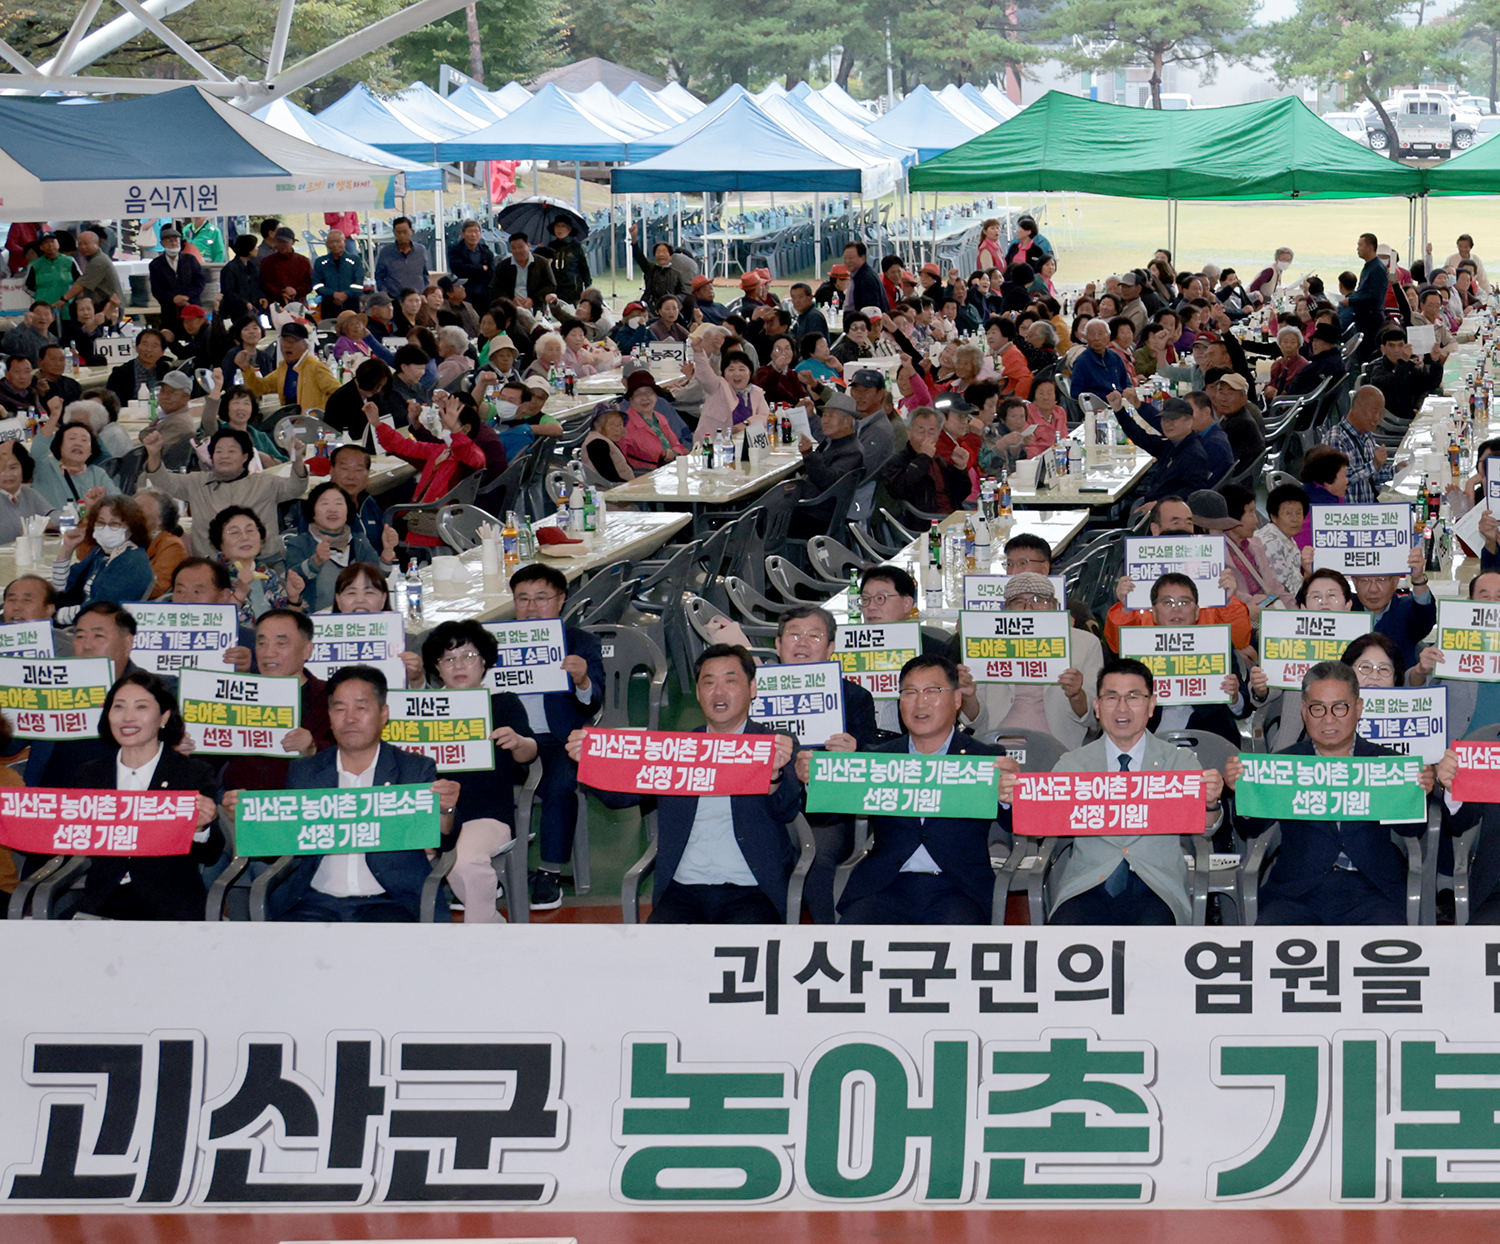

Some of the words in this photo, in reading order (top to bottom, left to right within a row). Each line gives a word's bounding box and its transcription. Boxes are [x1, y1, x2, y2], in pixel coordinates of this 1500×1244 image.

[124, 184, 218, 213] 음식지원
[1315, 530, 1347, 548] 농어촌
[1349, 530, 1372, 547] 기본
[1374, 528, 1407, 546] 소득이
[1344, 551, 1380, 567] 만든다!
[1130, 564, 1162, 581] 농어촌
[136, 612, 178, 627] 인구소멸
[180, 612, 201, 627] 없는
[203, 612, 222, 627] 괴산
[994, 616, 1034, 635] 괴산군
[1295, 616, 1336, 637] 괴산군
[166, 632, 191, 650] 기본
[193, 631, 233, 649] 소득이
[844, 629, 885, 648] 괴산군
[967, 637, 1007, 658] 농어촌
[1011, 637, 1065, 657] 기본소득
[1154, 633, 1195, 651] 괴산군
[1266, 638, 1306, 660] 농어촌
[1442, 629, 1482, 650] 농어촌
[333, 642, 359, 660] 기본
[525, 645, 562, 665] 소득이
[986, 660, 1012, 678] 선정
[1020, 660, 1047, 678] 기원!
[1170, 654, 1225, 674] 기본소득
[1458, 654, 1485, 674] 선정
[23, 665, 68, 685] 괴산군
[494, 670, 534, 688] 만든다!
[779, 672, 802, 690] 없는
[804, 672, 825, 688] 괴산
[41, 687, 105, 709] 기본소득
[215, 679, 259, 701] 괴산군
[1176, 678, 1207, 697] 기원!
[183, 701, 228, 724] 농어촌
[232, 704, 293, 727] 기본소득
[405, 697, 450, 717] 괴산군
[767, 696, 796, 716] 기본
[797, 693, 838, 714] 소득이
[1388, 698, 1408, 713] 없는
[1412, 697, 1432, 712] 괴산
[17, 712, 45, 732] 선정
[50, 712, 87, 732] 기원!
[423, 719, 485, 741] 기본소득
[1374, 719, 1400, 737] 기본
[1403, 716, 1443, 737] 소득이
[203, 728, 232, 748] 선정
[237, 729, 273, 748] 기원!
[588, 734, 640, 760] 괴산군
[643, 736, 698, 762] 농어촌
[699, 739, 772, 767] 기본소득
[635, 767, 673, 791] 선정
[677, 768, 715, 791] 기원!
[815, 757, 867, 783] 괴산군
[869, 758, 922, 784] 농어촌
[924, 760, 994, 786] 기본소득
[1242, 759, 1294, 786] 괴산군
[1296, 760, 1350, 787] 농어촌
[1352, 761, 1420, 788] 기본소득
[1018, 776, 1072, 801] 괴산군
[1074, 774, 1128, 801] 농어촌
[1130, 773, 1200, 799] 기본소득
[1, 792, 58, 819] 괴산군
[60, 793, 117, 820] 농어촌
[119, 793, 196, 822] 기본소득
[242, 795, 298, 822] 괴산군
[300, 793, 356, 820] 농어촌
[363, 790, 434, 818] 기본소득
[863, 787, 898, 811] 선정
[901, 788, 941, 811] 기원!
[1292, 791, 1328, 816] 선정
[1331, 792, 1370, 816] 기원!
[1069, 804, 1105, 829] 선정
[1110, 803, 1148, 828] 기원!
[53, 824, 92, 850] 선정
[99, 824, 138, 851] 기원!
[297, 824, 338, 850] 선정
[343, 822, 381, 848] 기원!
[709, 940, 1126, 1015] 괴산군민의
[1184, 938, 1431, 1014] 염원을
[8, 1038, 558, 1201] 괴산군
[620, 1038, 1151, 1201] 농어촌
